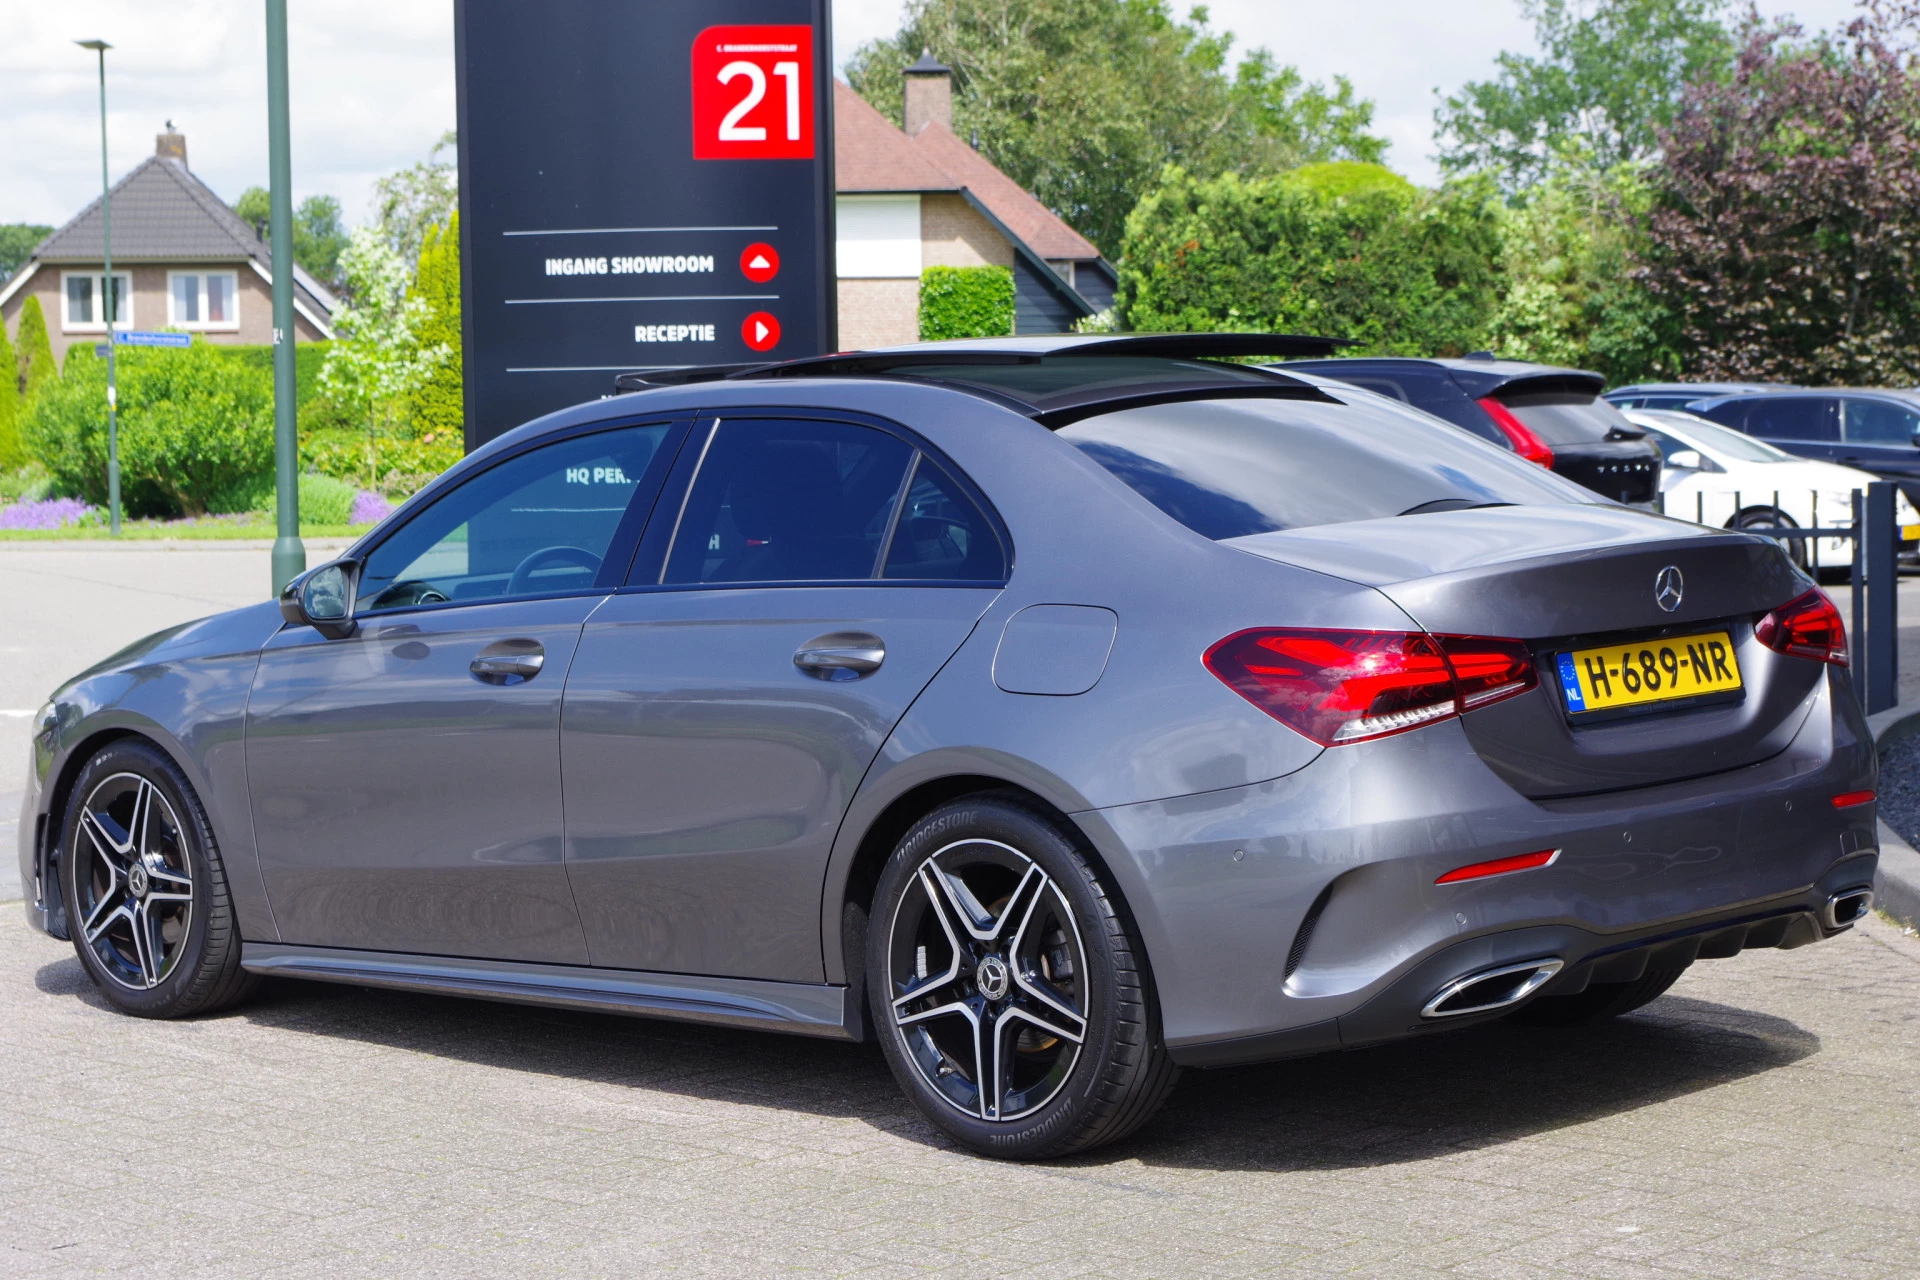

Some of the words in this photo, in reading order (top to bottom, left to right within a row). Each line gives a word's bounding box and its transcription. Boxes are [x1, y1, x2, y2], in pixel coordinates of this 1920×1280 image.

[716, 61, 800, 141] 21
[545, 258, 608, 275] INGANG
[611, 255, 714, 274] SHOWROOM
[634, 324, 715, 342] RECEPTIE
[566, 467, 589, 486] HQ
[594, 467, 631, 484] PER
[1583, 641, 1734, 699] H-689-NR
[1566, 687, 1582, 702] NL
[896, 811, 979, 863] BRIDGESTONE
[989, 1096, 1078, 1148] BRIDGESTONE
